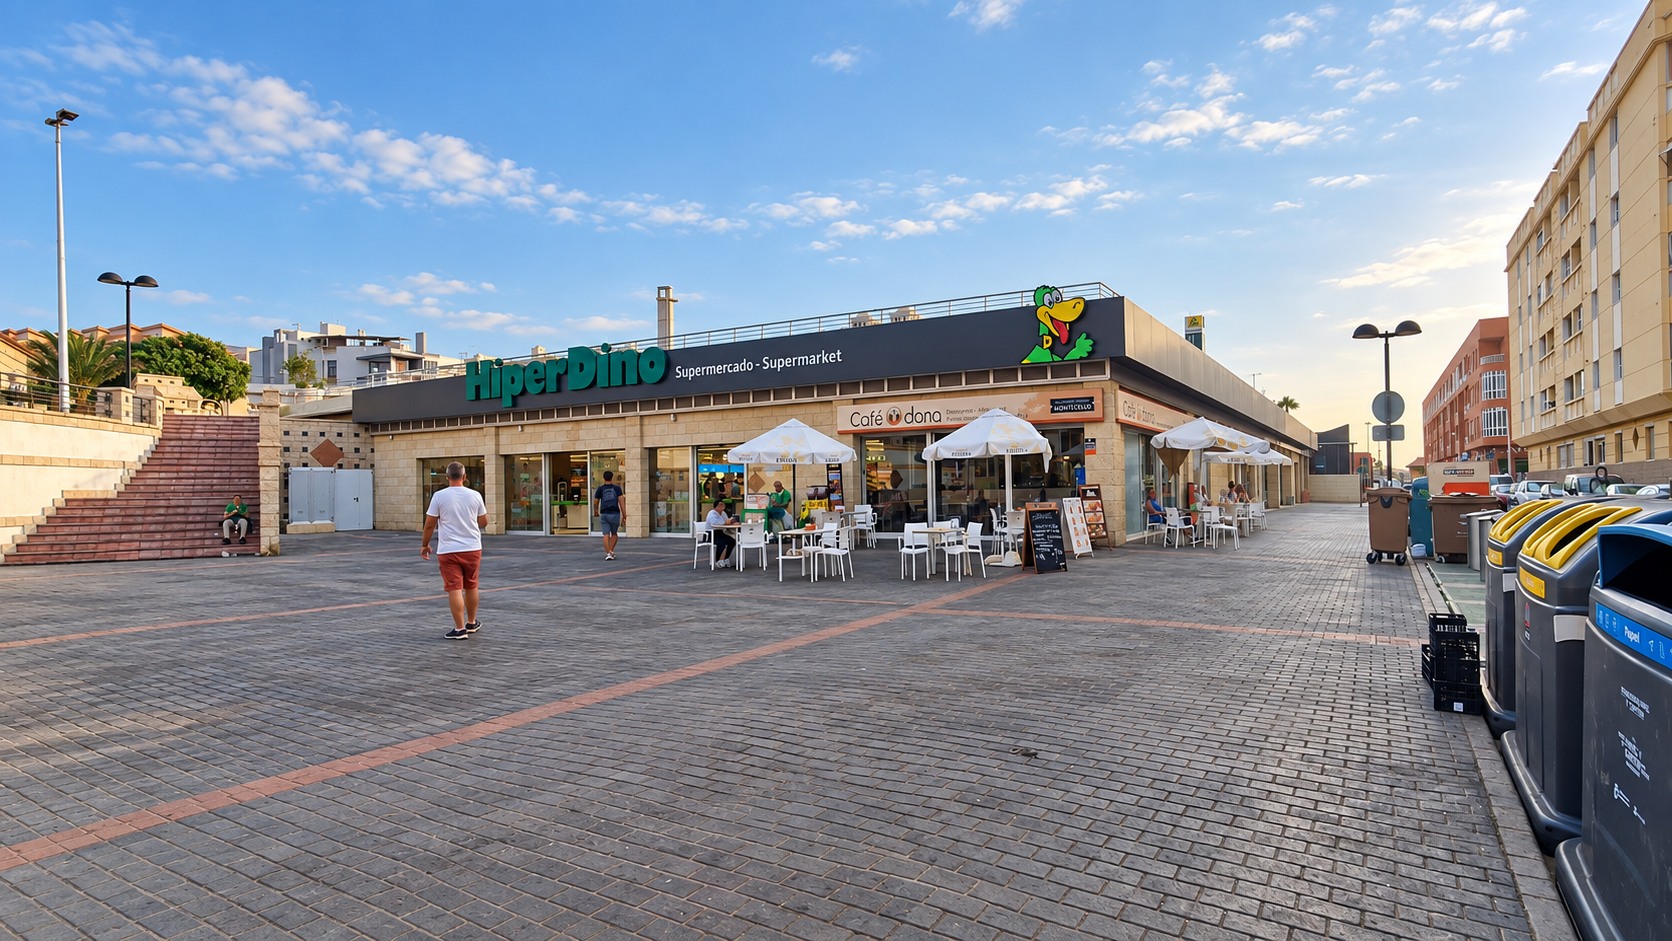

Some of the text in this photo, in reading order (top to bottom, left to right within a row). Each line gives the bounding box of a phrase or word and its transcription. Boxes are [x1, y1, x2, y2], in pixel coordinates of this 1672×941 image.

[466, 342, 667, 408] HiperDino
[675, 358, 754, 380] Supermercado
[762, 349, 843, 372] Supermarket
[850, 409, 883, 428] Café
[904, 405, 942, 425] dona
